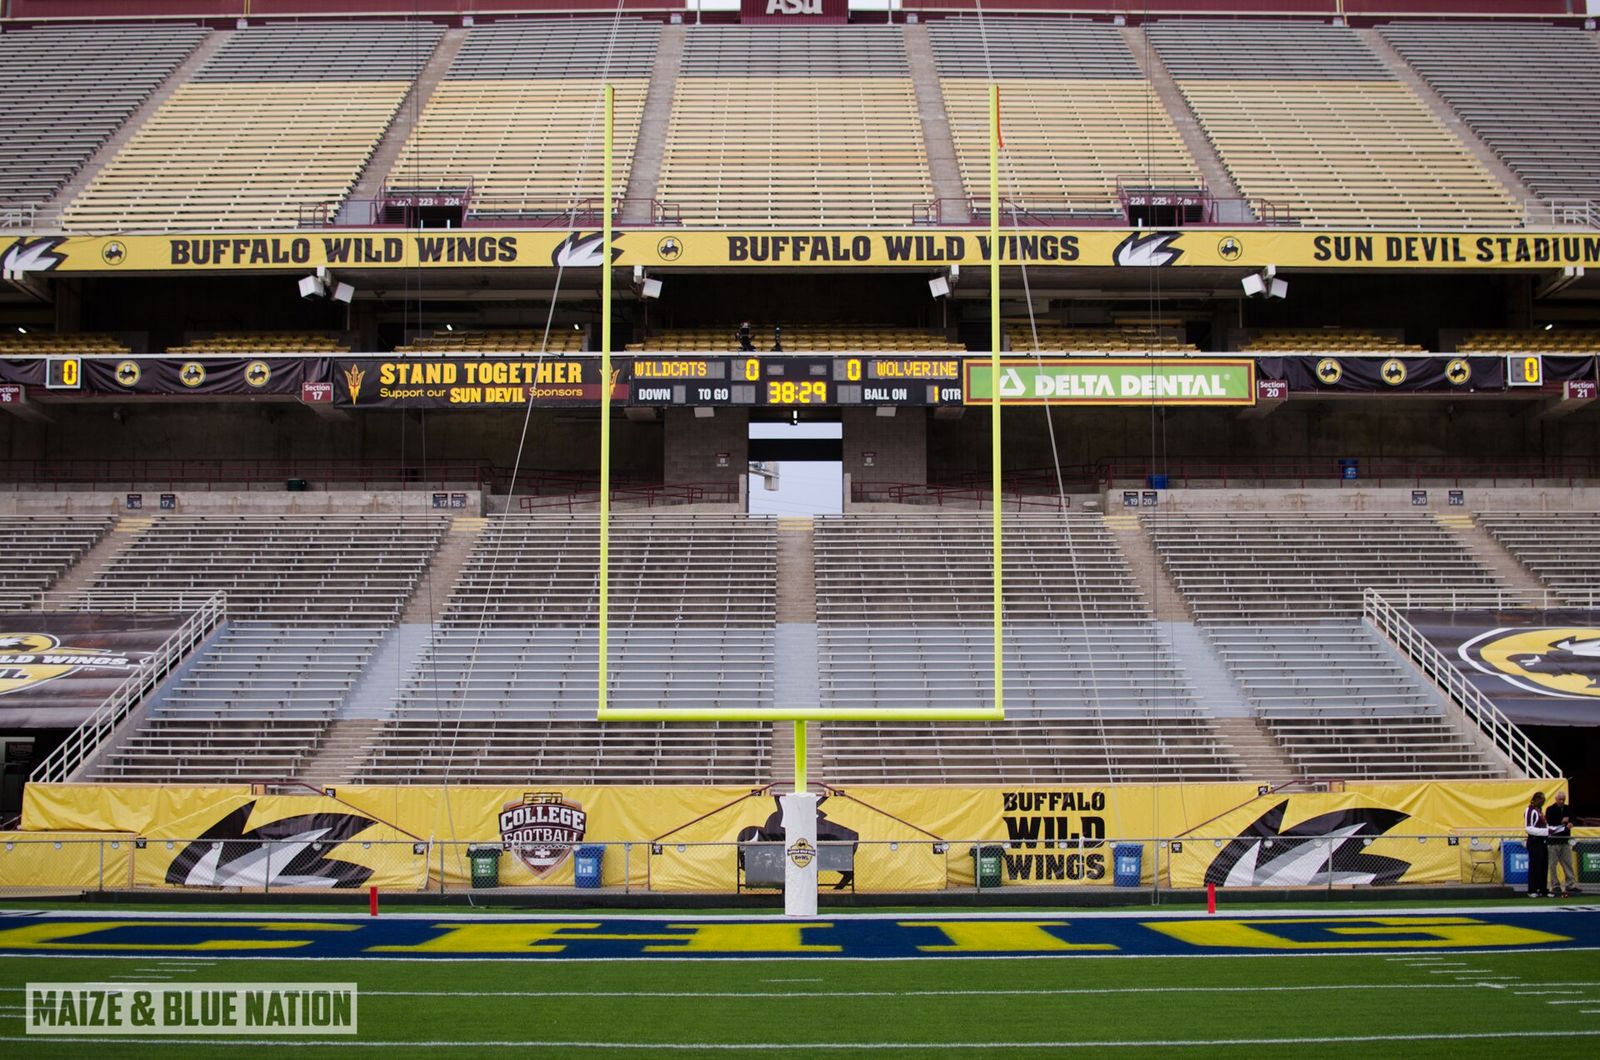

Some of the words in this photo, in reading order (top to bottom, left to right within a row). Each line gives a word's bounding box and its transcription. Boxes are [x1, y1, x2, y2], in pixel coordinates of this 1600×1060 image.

[418, 198, 433, 206] 223
[444, 198, 460, 206] 224
[1130, 197, 1146, 205] 224
[1152, 197, 1166, 205] 225
[170, 238, 311, 264] BUFFALO
[321, 238, 404, 263] WILD
[414, 236, 518, 262] WINGS
[727, 235, 871, 261] BUFFALO
[882, 235, 965, 261] WILD
[976, 235, 1080, 261] WINGS
[1313, 235, 1373, 262] SUN
[1386, 236, 1466, 262] DEVIL
[64, 360, 78, 385] 0
[379, 362, 457, 385] STAND
[463, 362, 583, 385] TOGETHER
[634, 362, 707, 376] WILDCATS
[746, 359, 760, 381] 0
[847, 359, 862, 381] 0
[876, 362, 958, 376] WOLVERINE
[1524, 357, 1538, 382] 0
[768, 382, 828, 403] 38:29
[1035, 374, 1116, 396] DELTA
[1120, 374, 1227, 396] DENTAL
[1266, 388, 1279, 398] 20
[1578, 388, 1588, 398] 21
[1, 393, 12, 402] 16
[312, 392, 322, 400] 17
[380, 387, 424, 399] Support
[450, 387, 482, 404] SUN
[485, 387, 526, 403] DEVIL
[528, 388, 583, 399] Sponsors
[638, 388, 671, 400] DOWN
[698, 388, 712, 400] TO
[714, 388, 729, 400] GO
[864, 388, 890, 400] BALL
[892, 388, 908, 400] ON
[941, 388, 962, 400] QTR
[43, 655, 128, 665] WINGS
[524, 792, 562, 804] ESPN
[1002, 792, 1105, 811] BUFFALO
[500, 806, 585, 832] COLLEGE
[1002, 816, 1105, 848] WILD
[1002, 854, 1105, 880] WINGS
